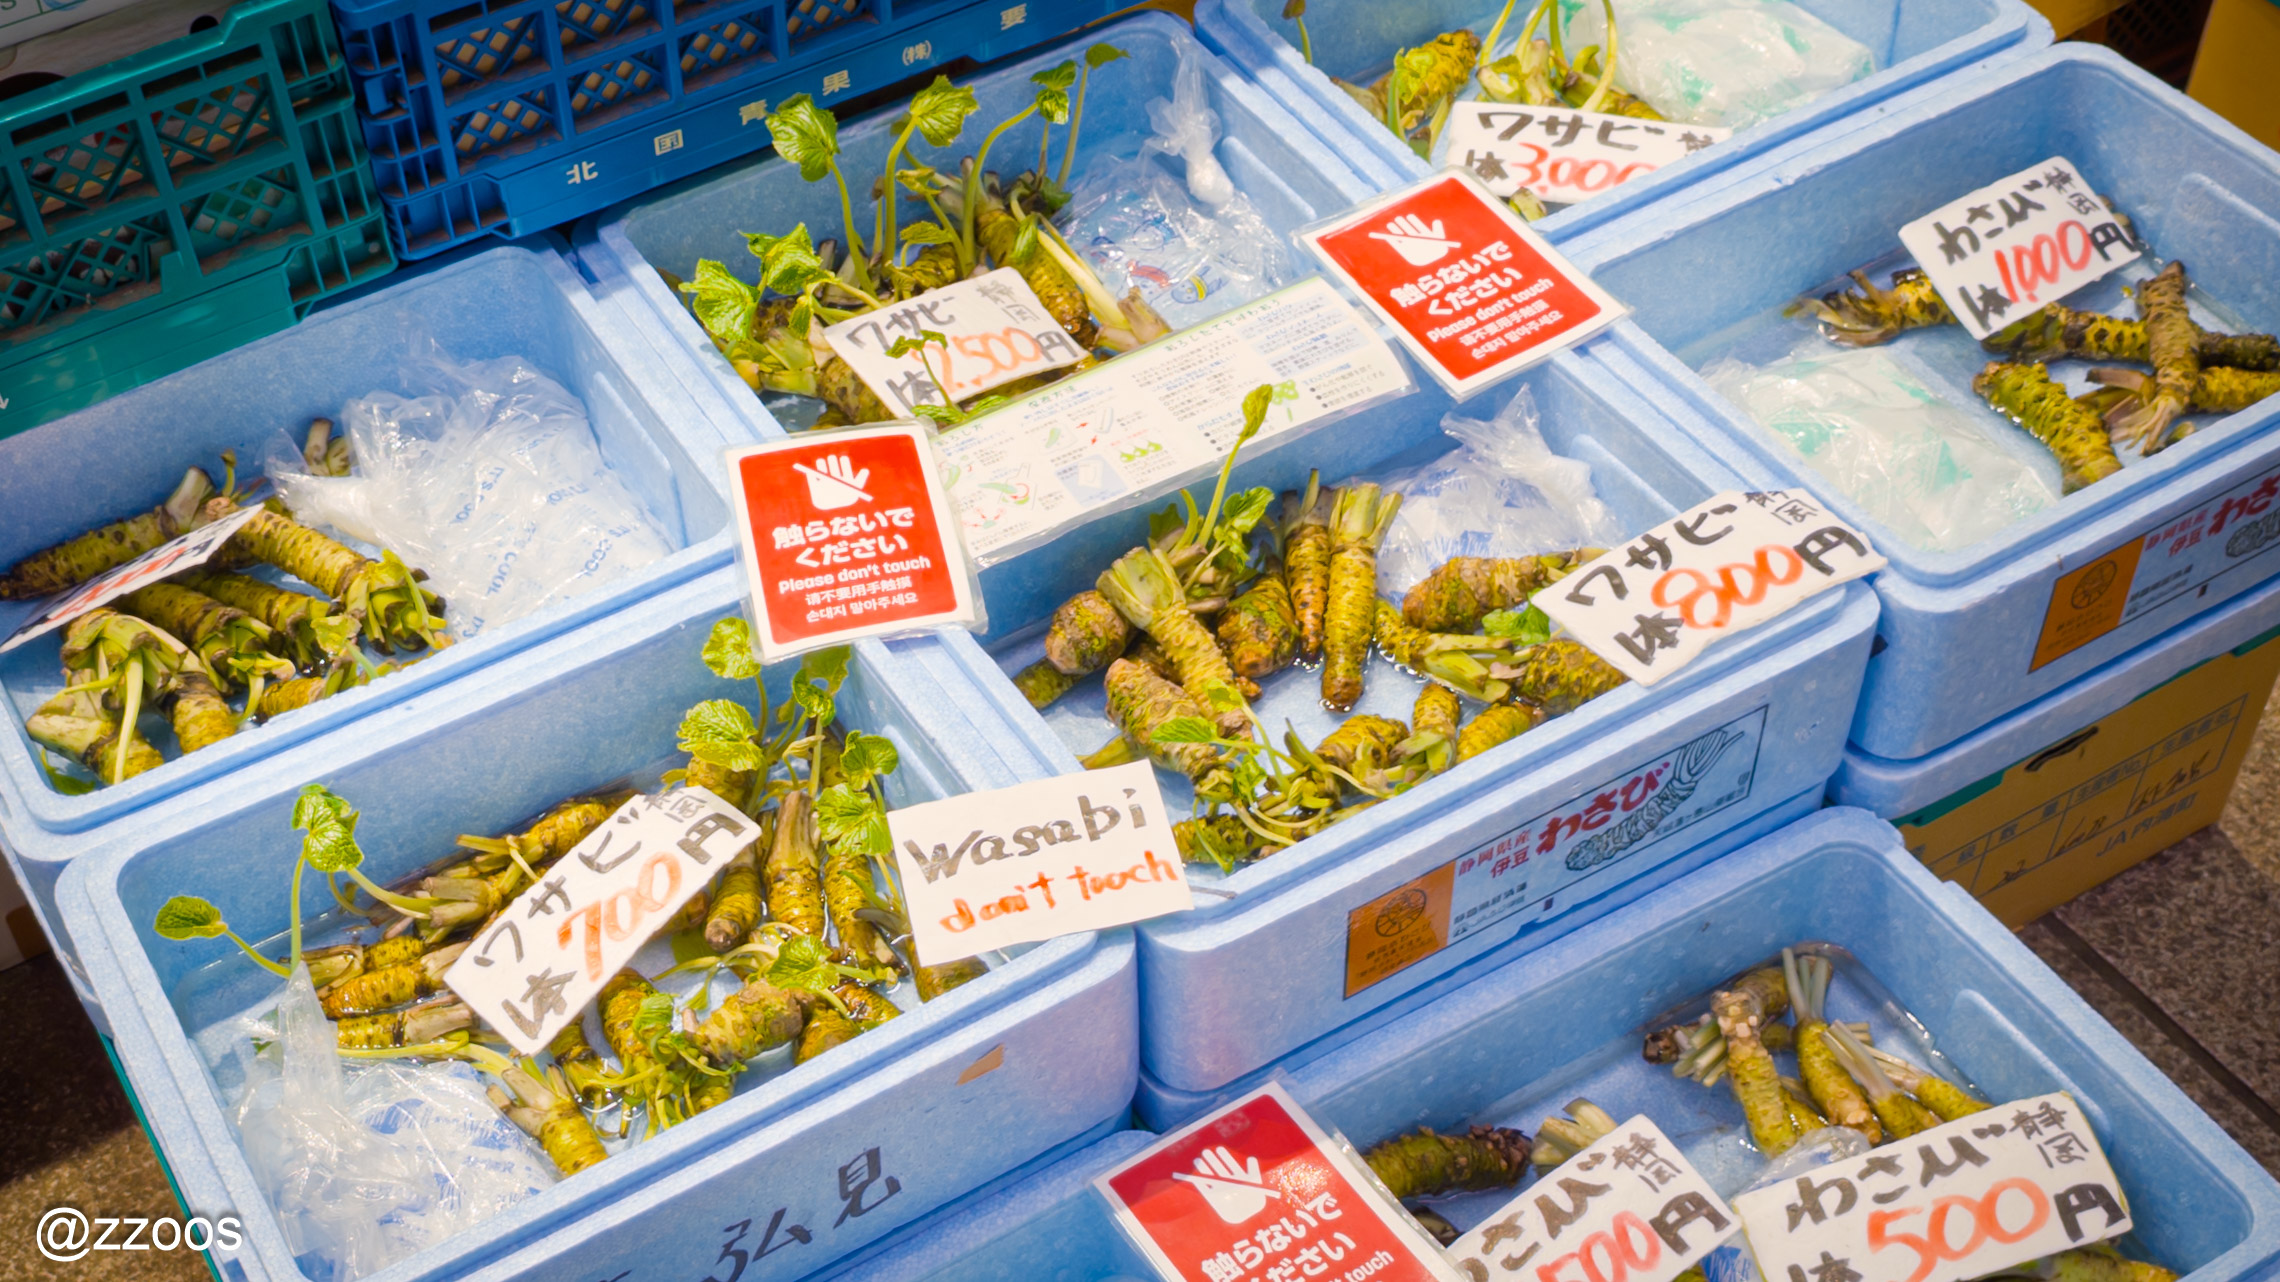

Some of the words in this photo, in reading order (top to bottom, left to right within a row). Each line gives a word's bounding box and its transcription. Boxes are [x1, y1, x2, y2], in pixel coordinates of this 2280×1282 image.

[1477, 111, 1665, 151] ワサビ
[1390, 240, 1514, 309] 触らないで
[1428, 267, 1523, 317] ください
[1426, 315, 1478, 344] Please
[1475, 296, 1514, 322] don't
[1512, 277, 1556, 311] touch
[1458, 299, 1551, 347] 请不要用手触摸
[1470, 332, 1509, 360] 손대지
[1504, 310, 1564, 344] 말아주세요
[771, 506, 916, 550] 触らないで
[794, 534, 910, 569] ください
[778, 572, 836, 595] Please
[838, 563, 881, 584] don't
[881, 555, 932, 576] touch
[1565, 503, 1739, 607] ワサビ
[804, 576, 914, 606] 请不要用手触摸
[805, 603, 848, 623] 손대지
[849, 591, 920, 615] 말아주세요
[1535, 761, 1671, 853] わさび
[903, 787, 1148, 886] Wasabi
[1458, 827, 1531, 877] 静岡県産
[473, 806, 643, 968] ワサビ
[1490, 844, 1531, 880] 伊豆
[1785, 1123, 2007, 1234] わさび
[1201, 1191, 1344, 1282] 触らないで
[1250, 1231, 1357, 1282] ださい
[1343, 1249, 1395, 1282] touch
